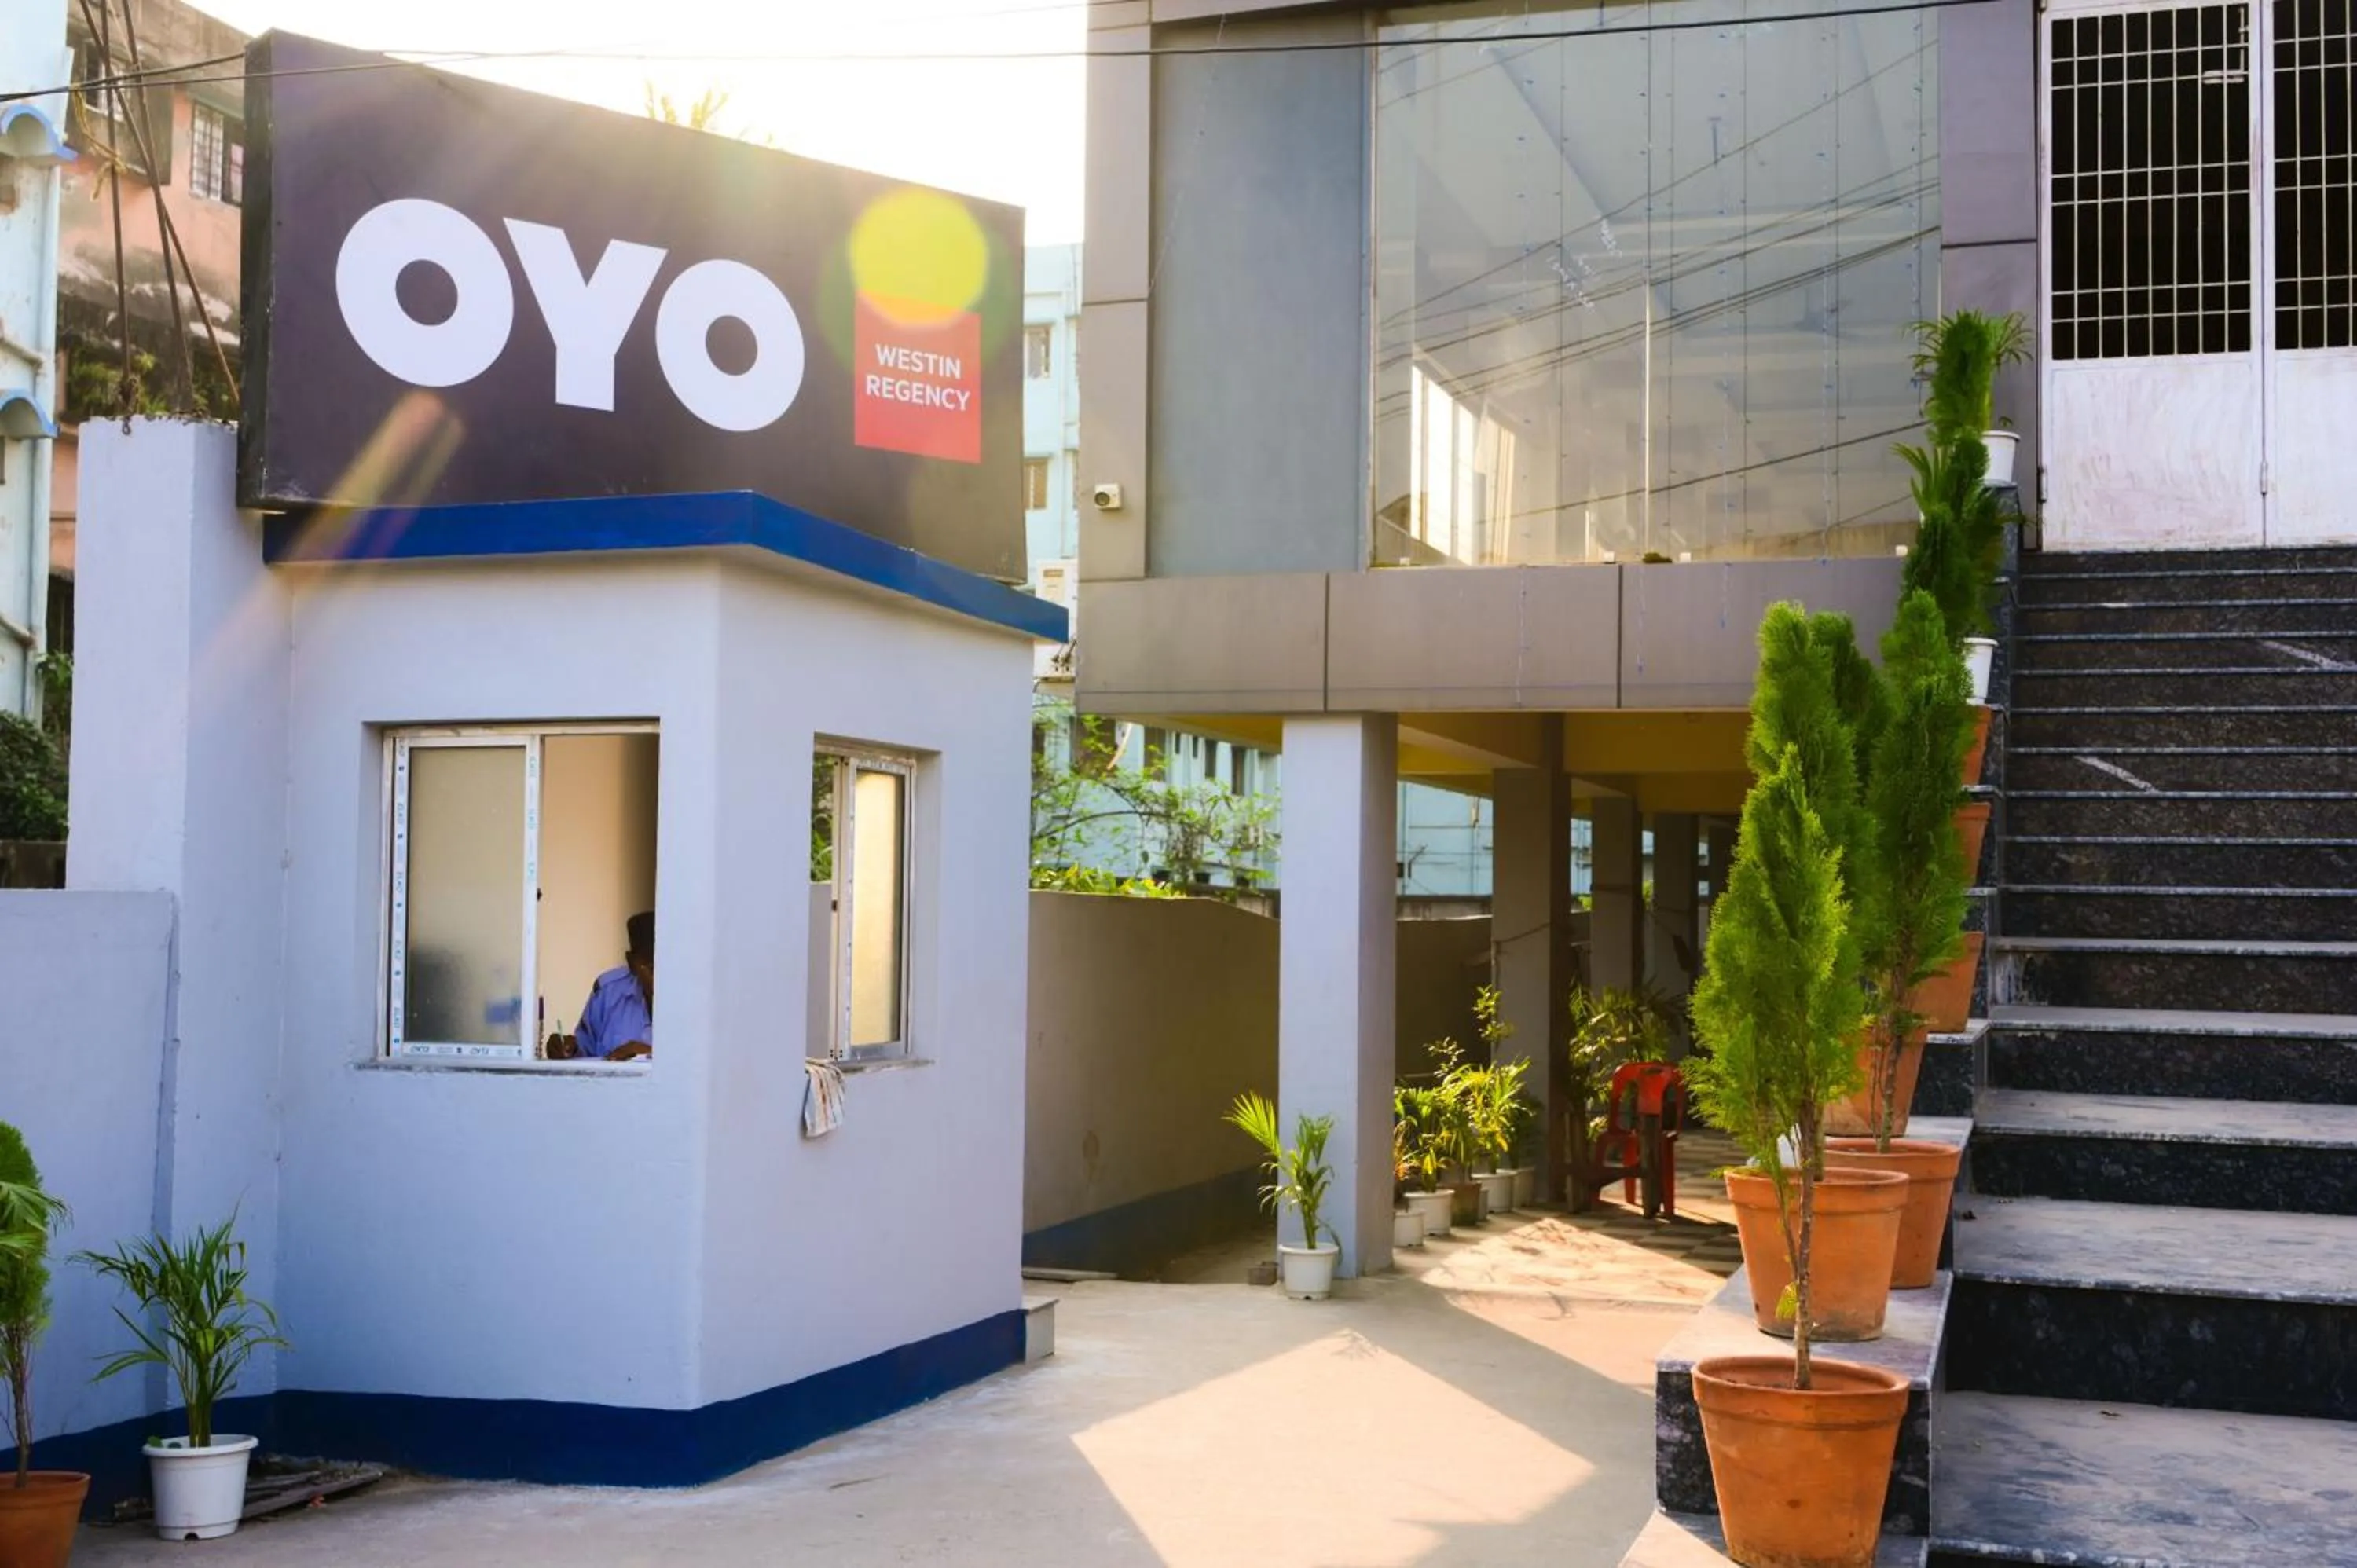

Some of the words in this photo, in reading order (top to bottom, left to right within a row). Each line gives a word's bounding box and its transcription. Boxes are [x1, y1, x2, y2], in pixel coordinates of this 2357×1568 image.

[335, 198, 805, 431] OYO
[875, 343, 961, 379] WESTIN
[866, 374, 971, 412] REGENCY
